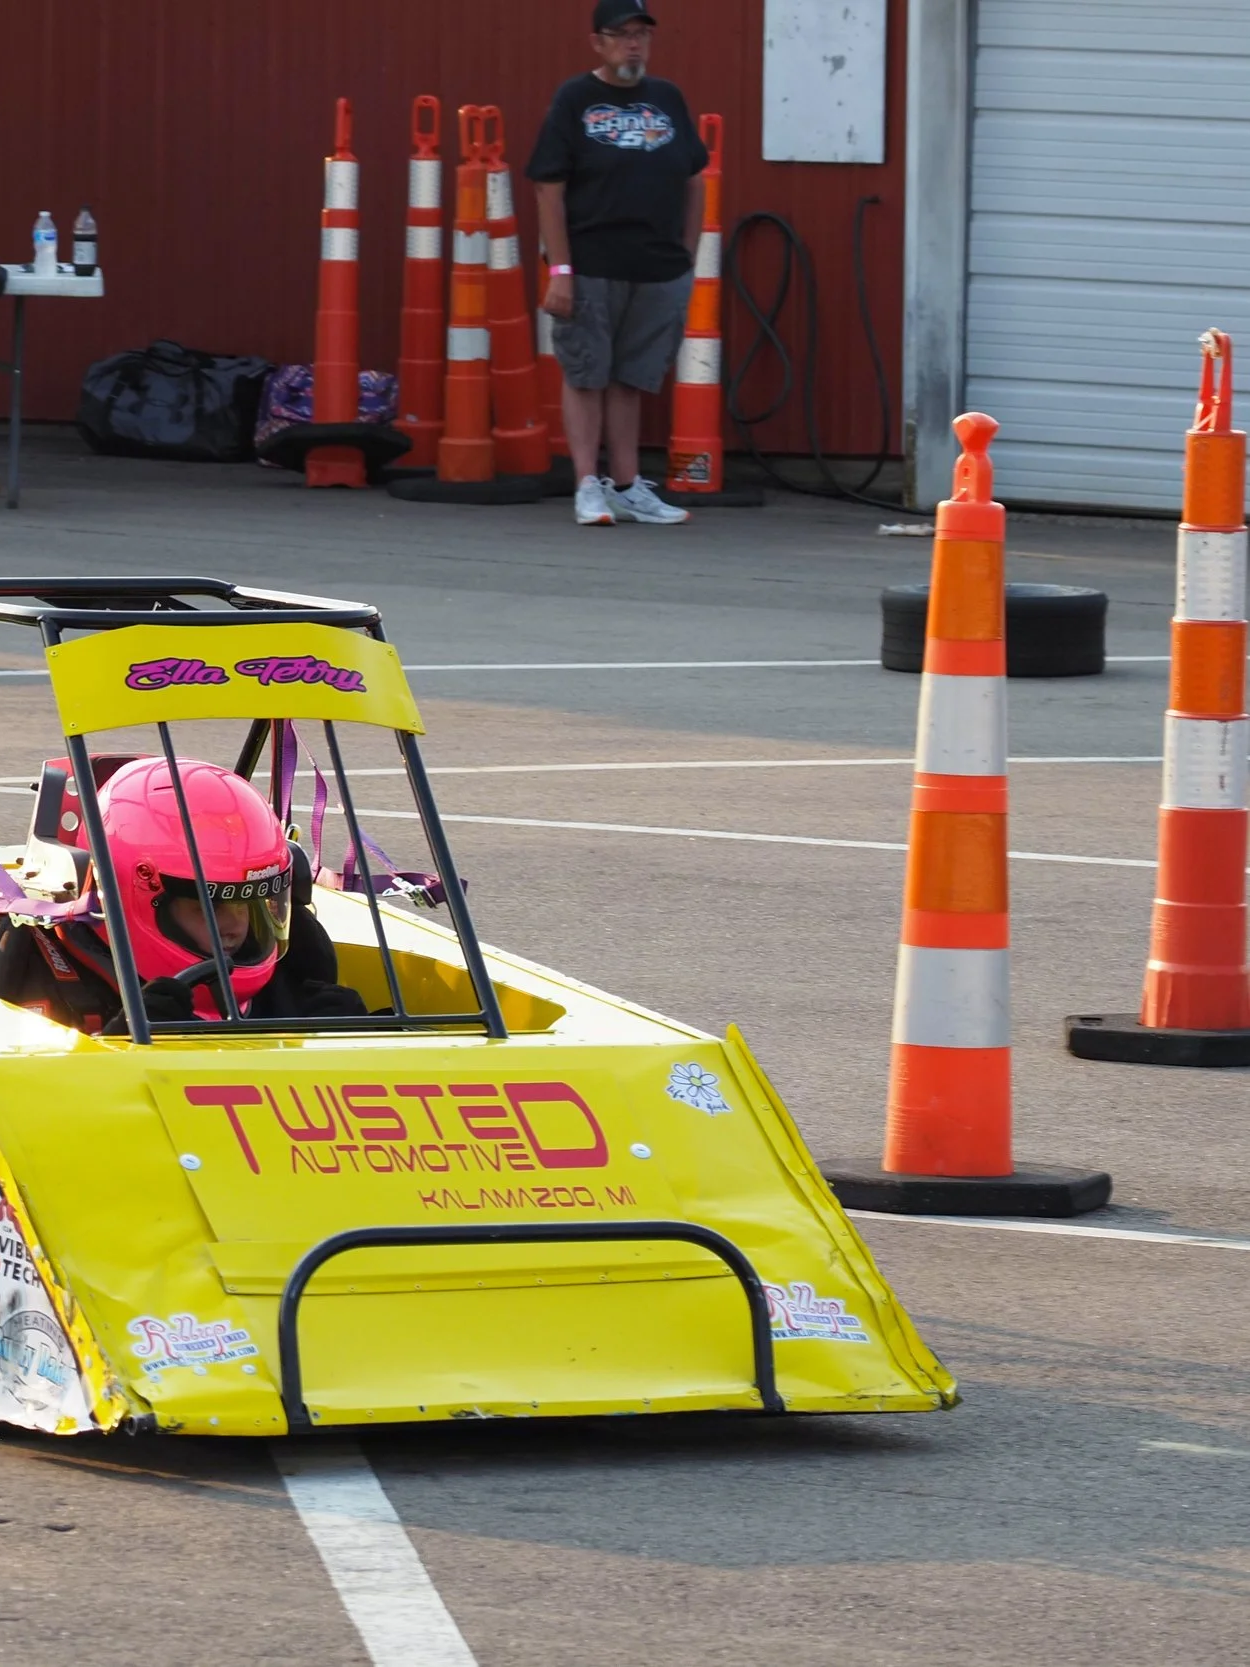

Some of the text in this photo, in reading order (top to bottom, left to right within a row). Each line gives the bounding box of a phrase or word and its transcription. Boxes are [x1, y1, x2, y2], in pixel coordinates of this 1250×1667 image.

[125, 655, 367, 693] Ella Terry
[184, 1082, 609, 1175] TWISTED
[291, 1143, 536, 1174] AUTOMOTIVE
[418, 1185, 638, 1211] KALAMAZOO, MI
[2, 1259, 41, 1289] TECH
